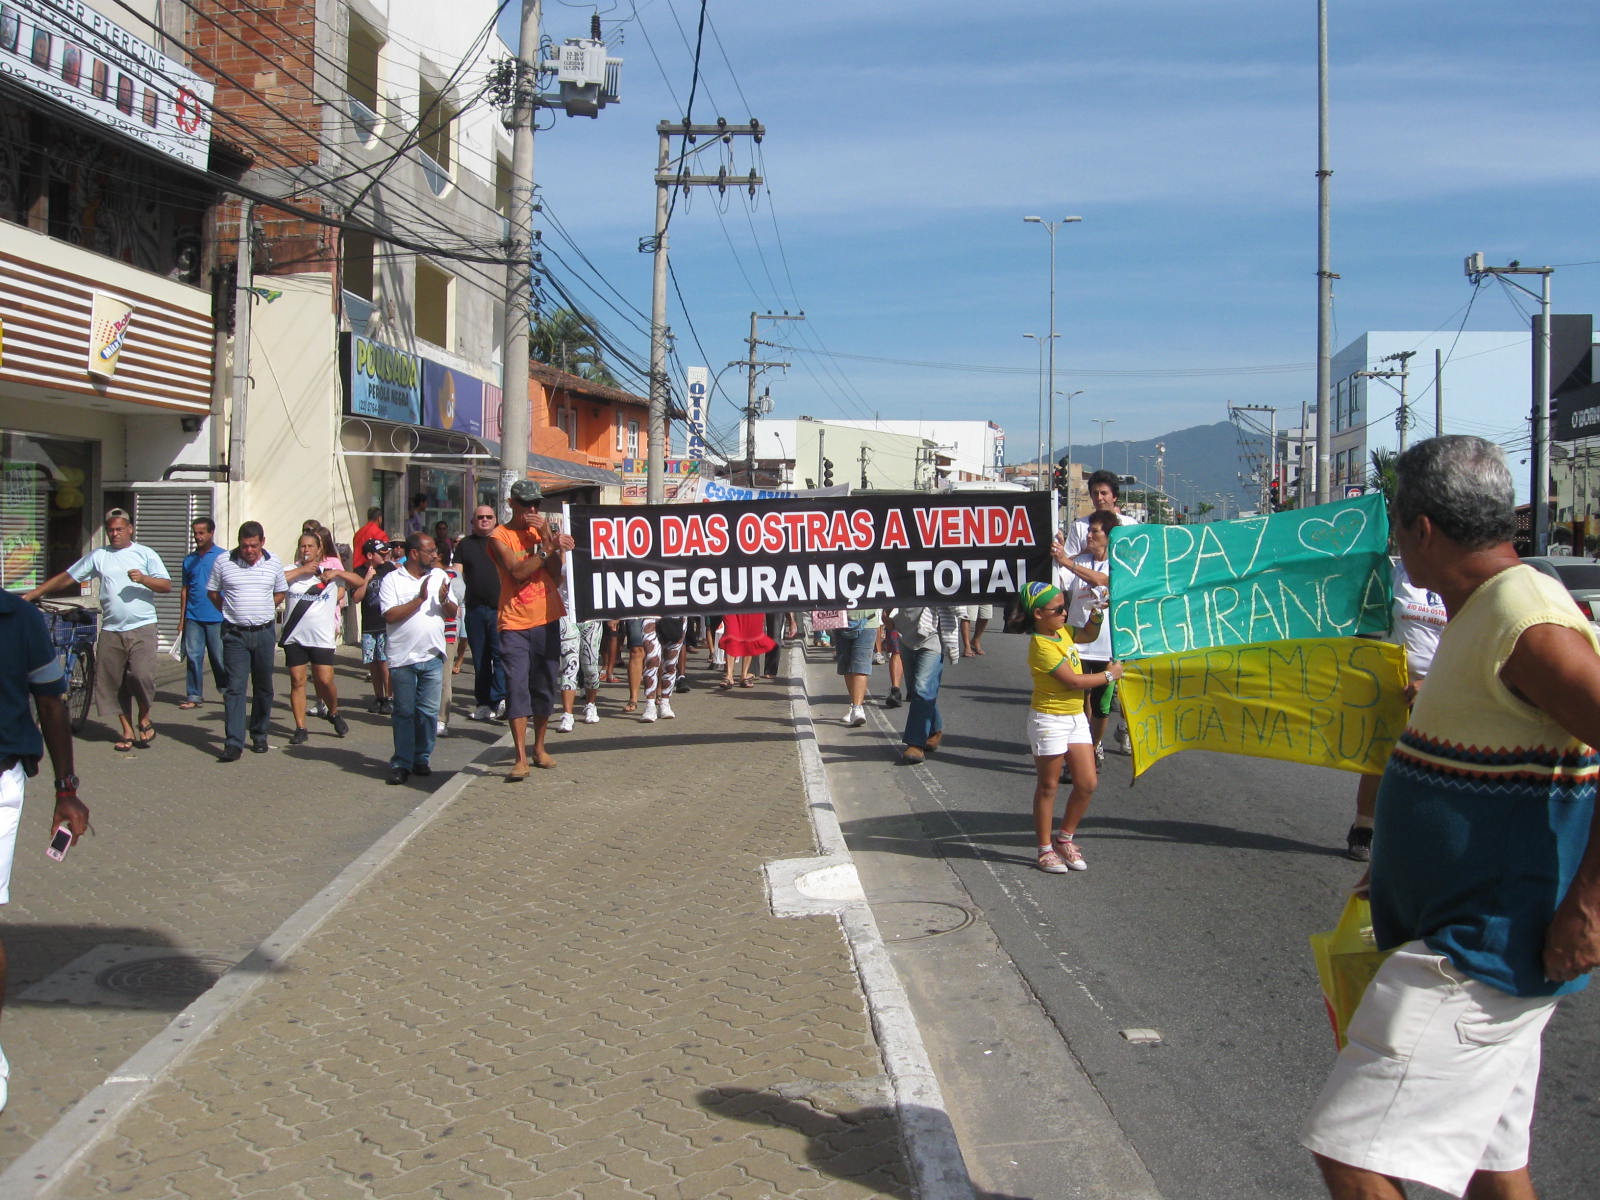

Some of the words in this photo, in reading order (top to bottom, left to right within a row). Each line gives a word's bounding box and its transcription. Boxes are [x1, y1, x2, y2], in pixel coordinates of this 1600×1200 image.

[92, 18, 166, 72] PIERCING
[356, 338, 418, 393] POUSADA
[689, 380, 706, 459] ÓTICAS
[590, 516, 653, 560] RIO
[660, 513, 730, 557] DAS
[736, 508, 875, 555] OSTRAS
[880, 508, 911, 550] A
[913, 505, 1036, 548] VENDA
[592, 562, 896, 610] INSEGURANÇA
[1114, 569, 1391, 657] SEGURANÇA
[1120, 643, 1382, 715] QUEREMOS
[1240, 706, 1293, 752] NA
